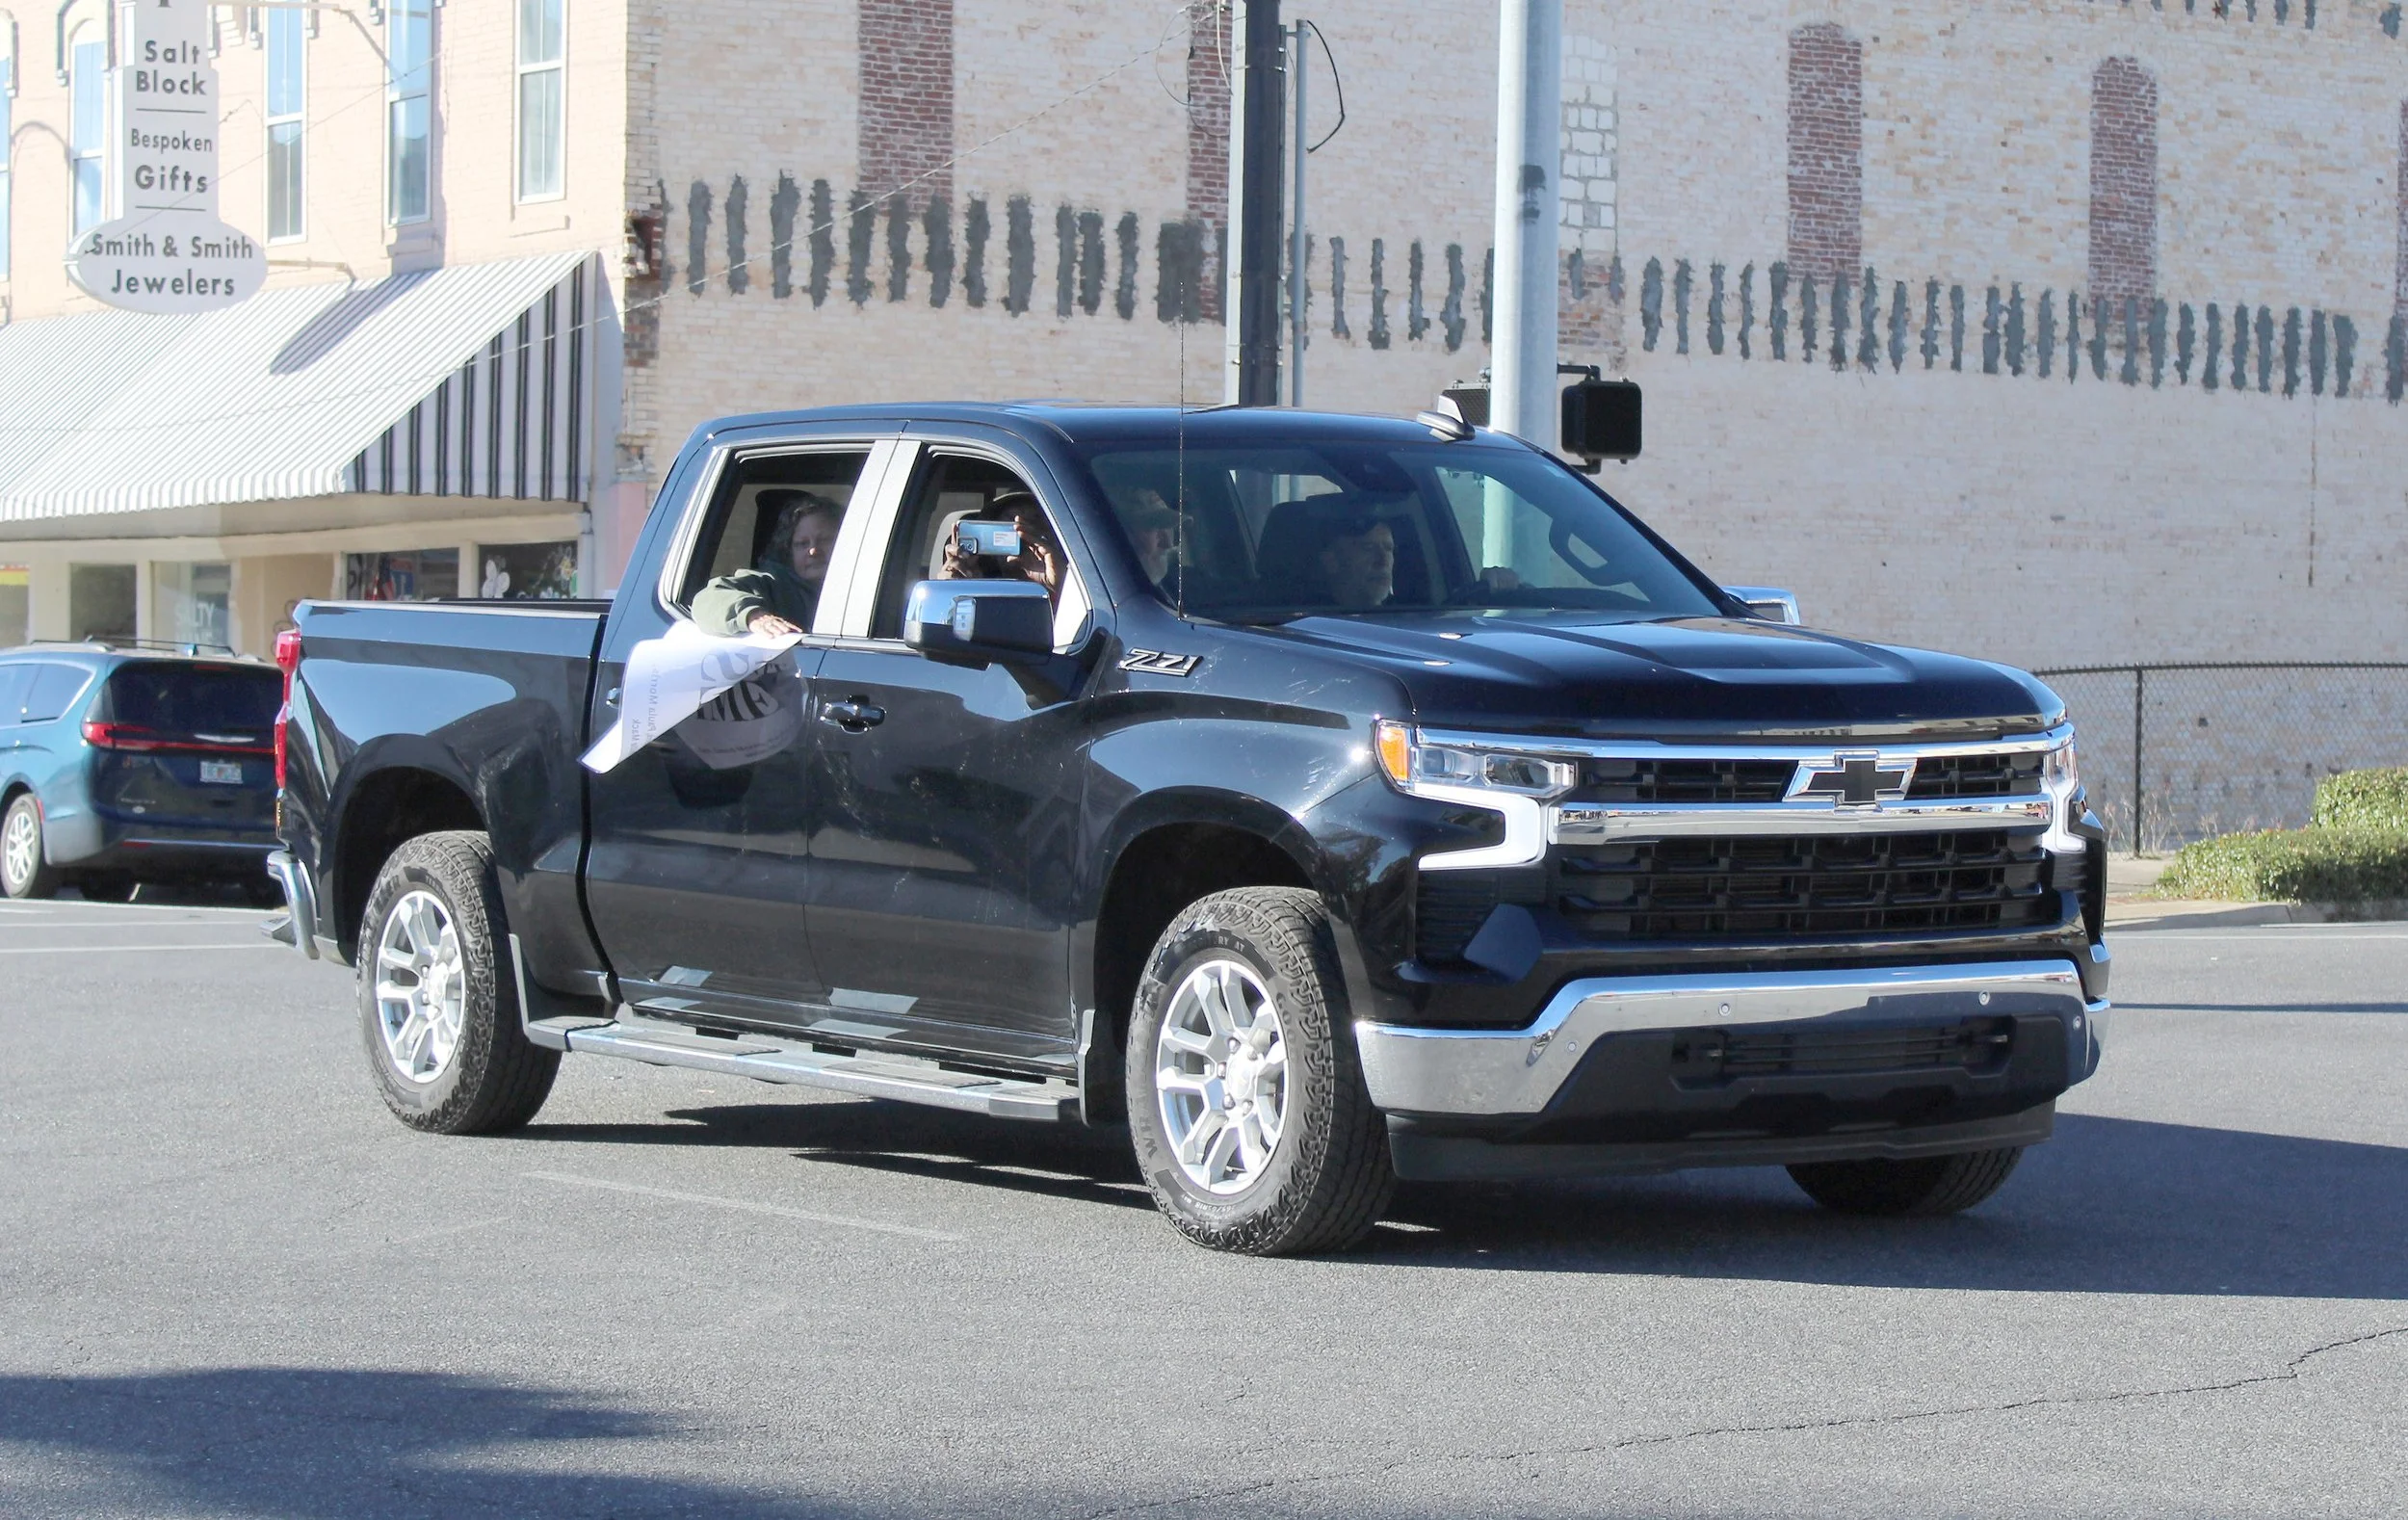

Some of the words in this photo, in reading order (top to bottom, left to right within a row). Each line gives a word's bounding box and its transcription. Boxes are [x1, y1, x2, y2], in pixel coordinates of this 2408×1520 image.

[144, 40, 200, 65] Salt
[136, 70, 207, 95] Block
[131, 128, 212, 153] Bespoken
[135, 165, 208, 194] Gifts
[92, 233, 155, 257] Smith
[162, 237, 179, 258] &
[191, 236, 253, 259] Smith
[111, 269, 235, 296] Jewelers
